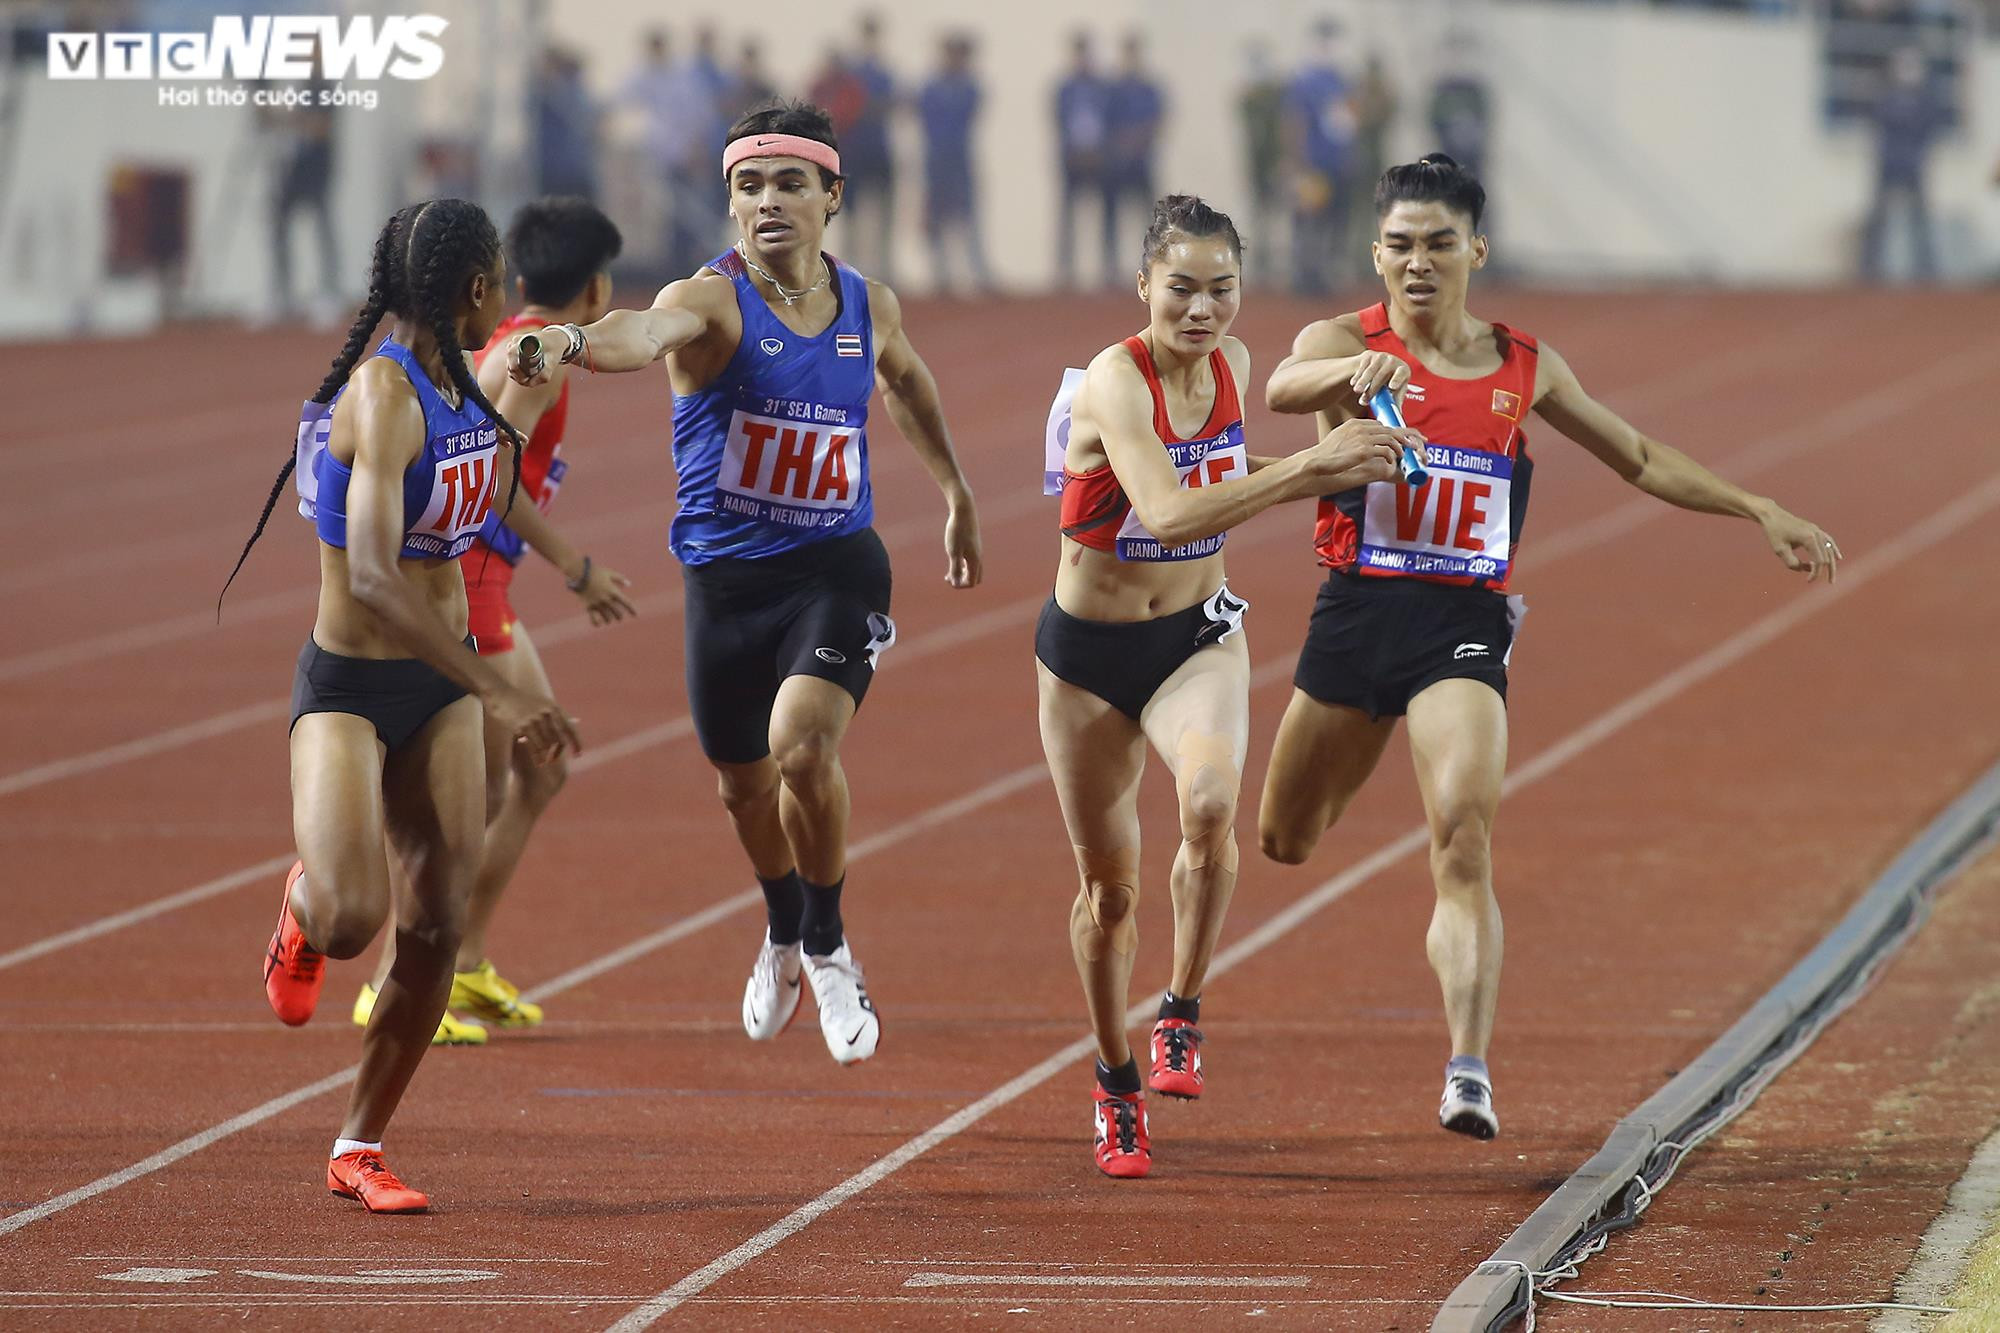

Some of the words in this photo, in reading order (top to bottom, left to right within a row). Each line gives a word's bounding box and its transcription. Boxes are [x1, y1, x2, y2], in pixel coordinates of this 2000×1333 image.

[787, 401, 811, 418] SEA
[815, 404, 846, 423] Games
[460, 431, 475, 450] SEA
[739, 420, 849, 501] THA
[1426, 447, 1450, 466] SEA
[1453, 451, 1493, 472] Games
[723, 495, 760, 517] HANOI
[770, 506, 820, 528] VIETNAM
[1395, 475, 1491, 552] VIE
[406, 534, 443, 555] HANOI
[1126, 542, 1161, 558] HANOI
[1369, 549, 1406, 569] HANOI
[1468, 559, 1497, 576] 2022
